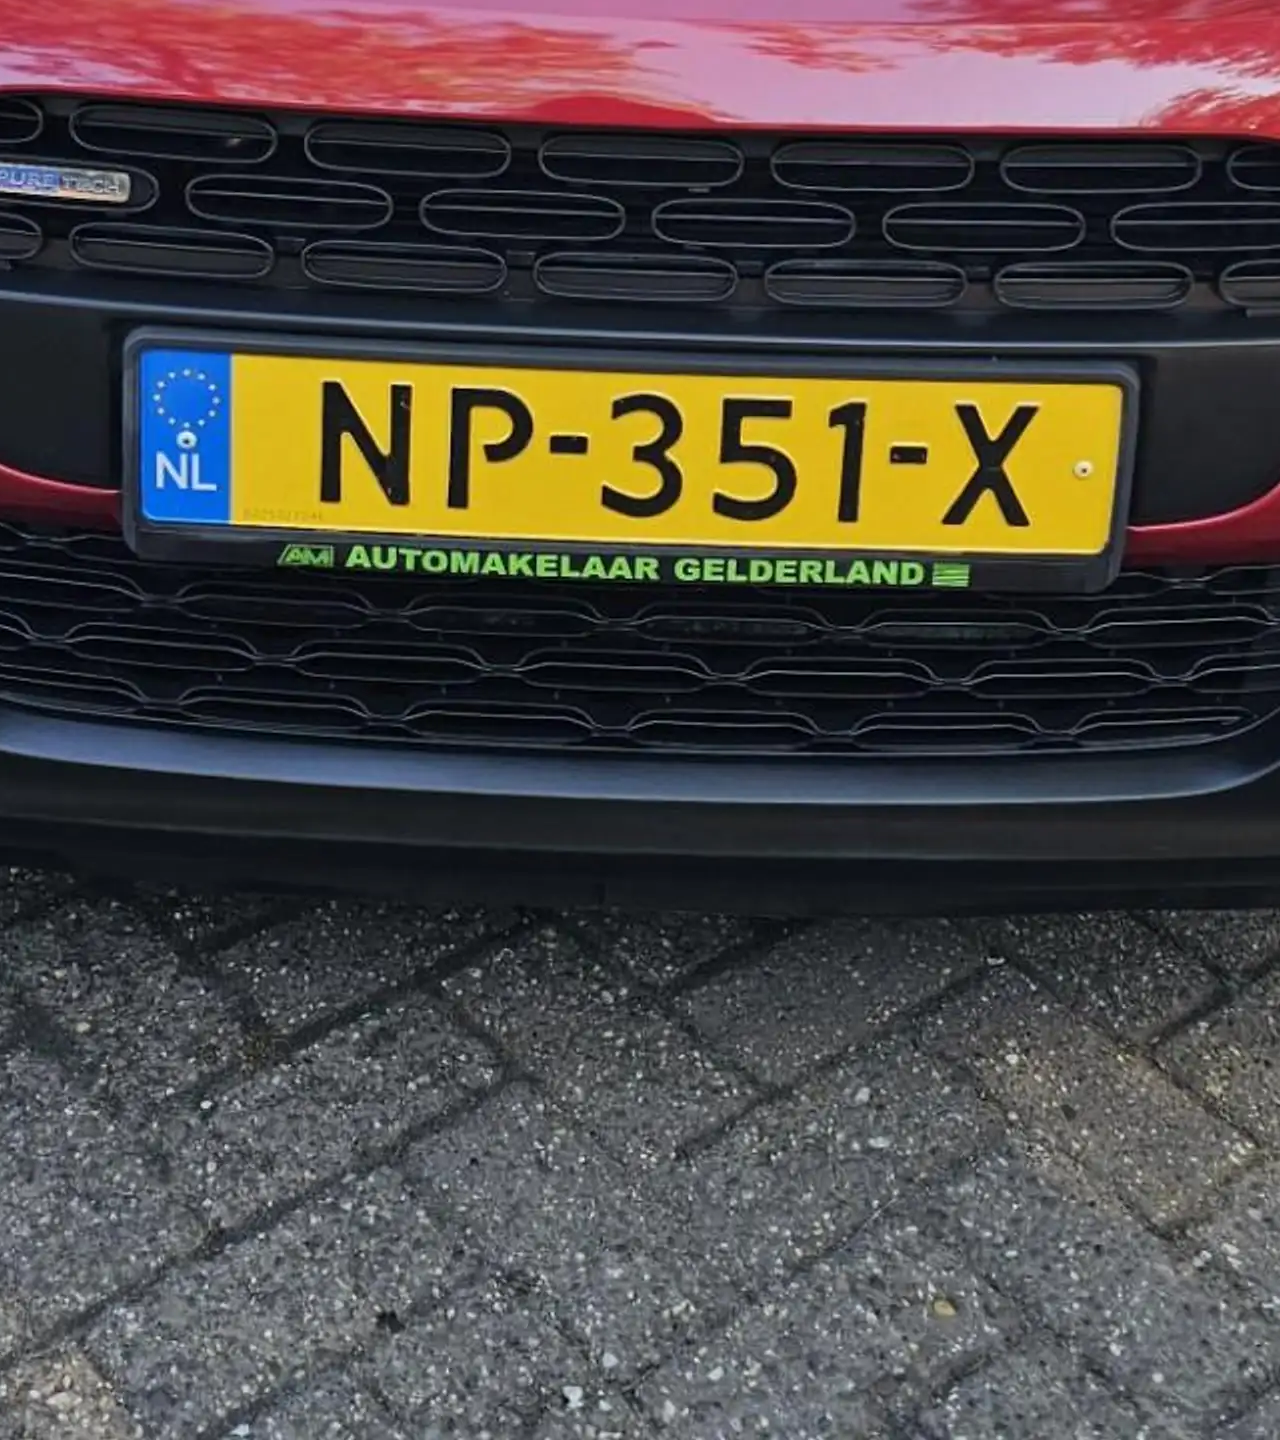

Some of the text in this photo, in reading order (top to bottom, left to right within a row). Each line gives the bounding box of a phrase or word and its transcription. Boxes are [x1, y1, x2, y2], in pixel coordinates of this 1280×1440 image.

[155, 451, 217, 491] NL
[320, 380, 1040, 528] NP-351-X
[344, 545, 660, 580] AUTOMAKELAAR
[674, 558, 925, 585] GELDERLAND
